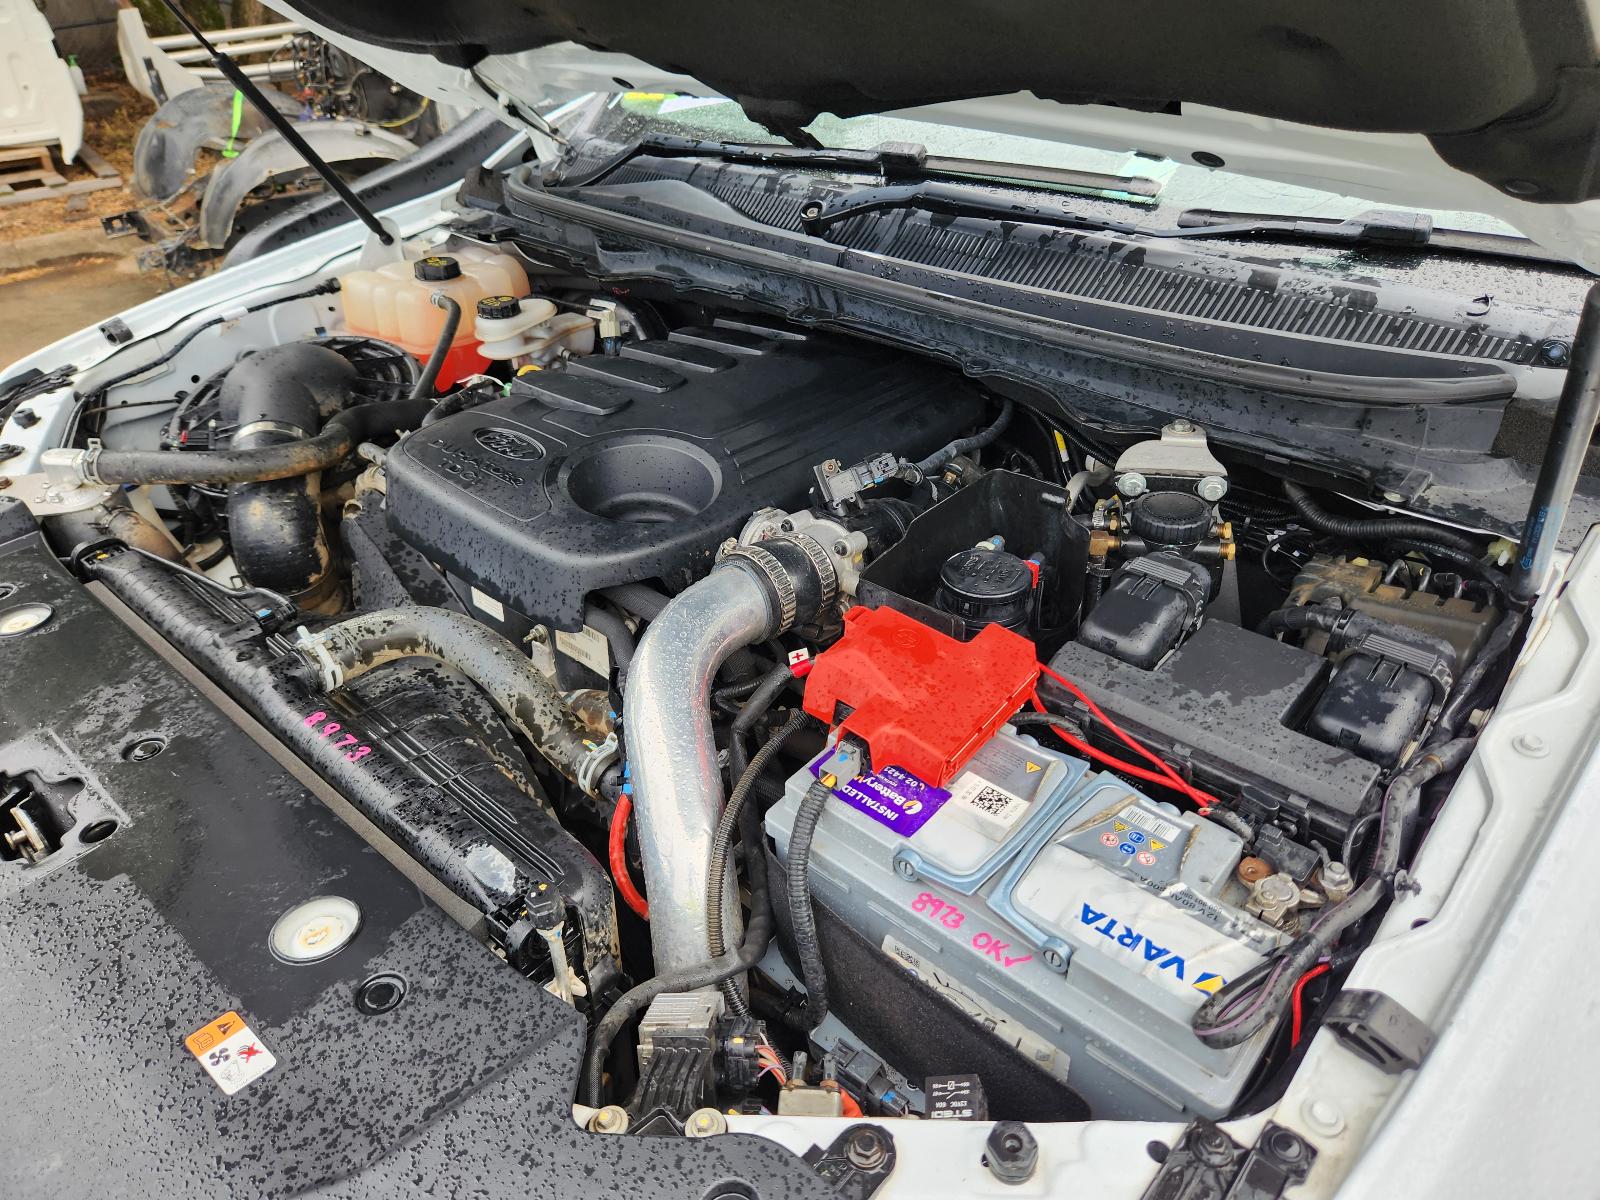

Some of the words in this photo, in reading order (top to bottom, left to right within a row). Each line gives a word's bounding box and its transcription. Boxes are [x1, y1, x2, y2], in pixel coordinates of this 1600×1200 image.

[478, 432, 534, 458] Ford
[304, 711, 372, 762] 8973
[841, 785, 900, 821] INSTALLED
[1080, 902, 1185, 981] VARTA
